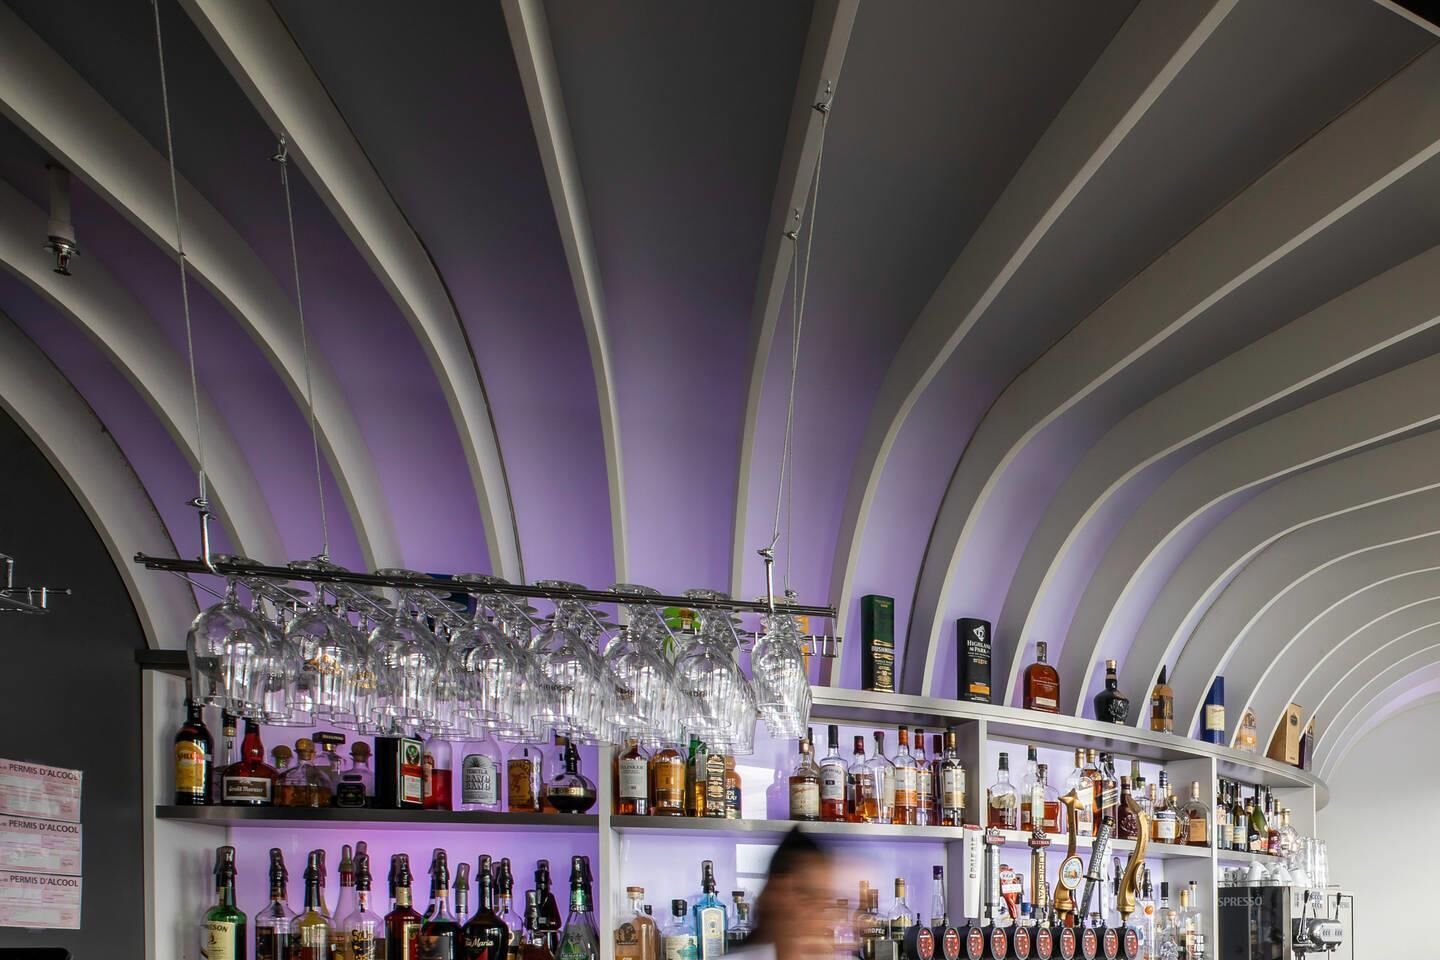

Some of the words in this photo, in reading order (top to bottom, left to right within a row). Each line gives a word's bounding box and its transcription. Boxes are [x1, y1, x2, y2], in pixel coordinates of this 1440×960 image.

[8, 763, 38, 775] PERMIS
[39, 768, 78, 780] D'ALCOOL
[8, 819, 37, 830] PERMIS
[39, 823, 79, 834] D'ALCOOL
[9, 875, 38, 885] PERMIS
[40, 878, 79, 888] D'ALCOOL
[1217, 896, 1262, 908] SPRESSO
